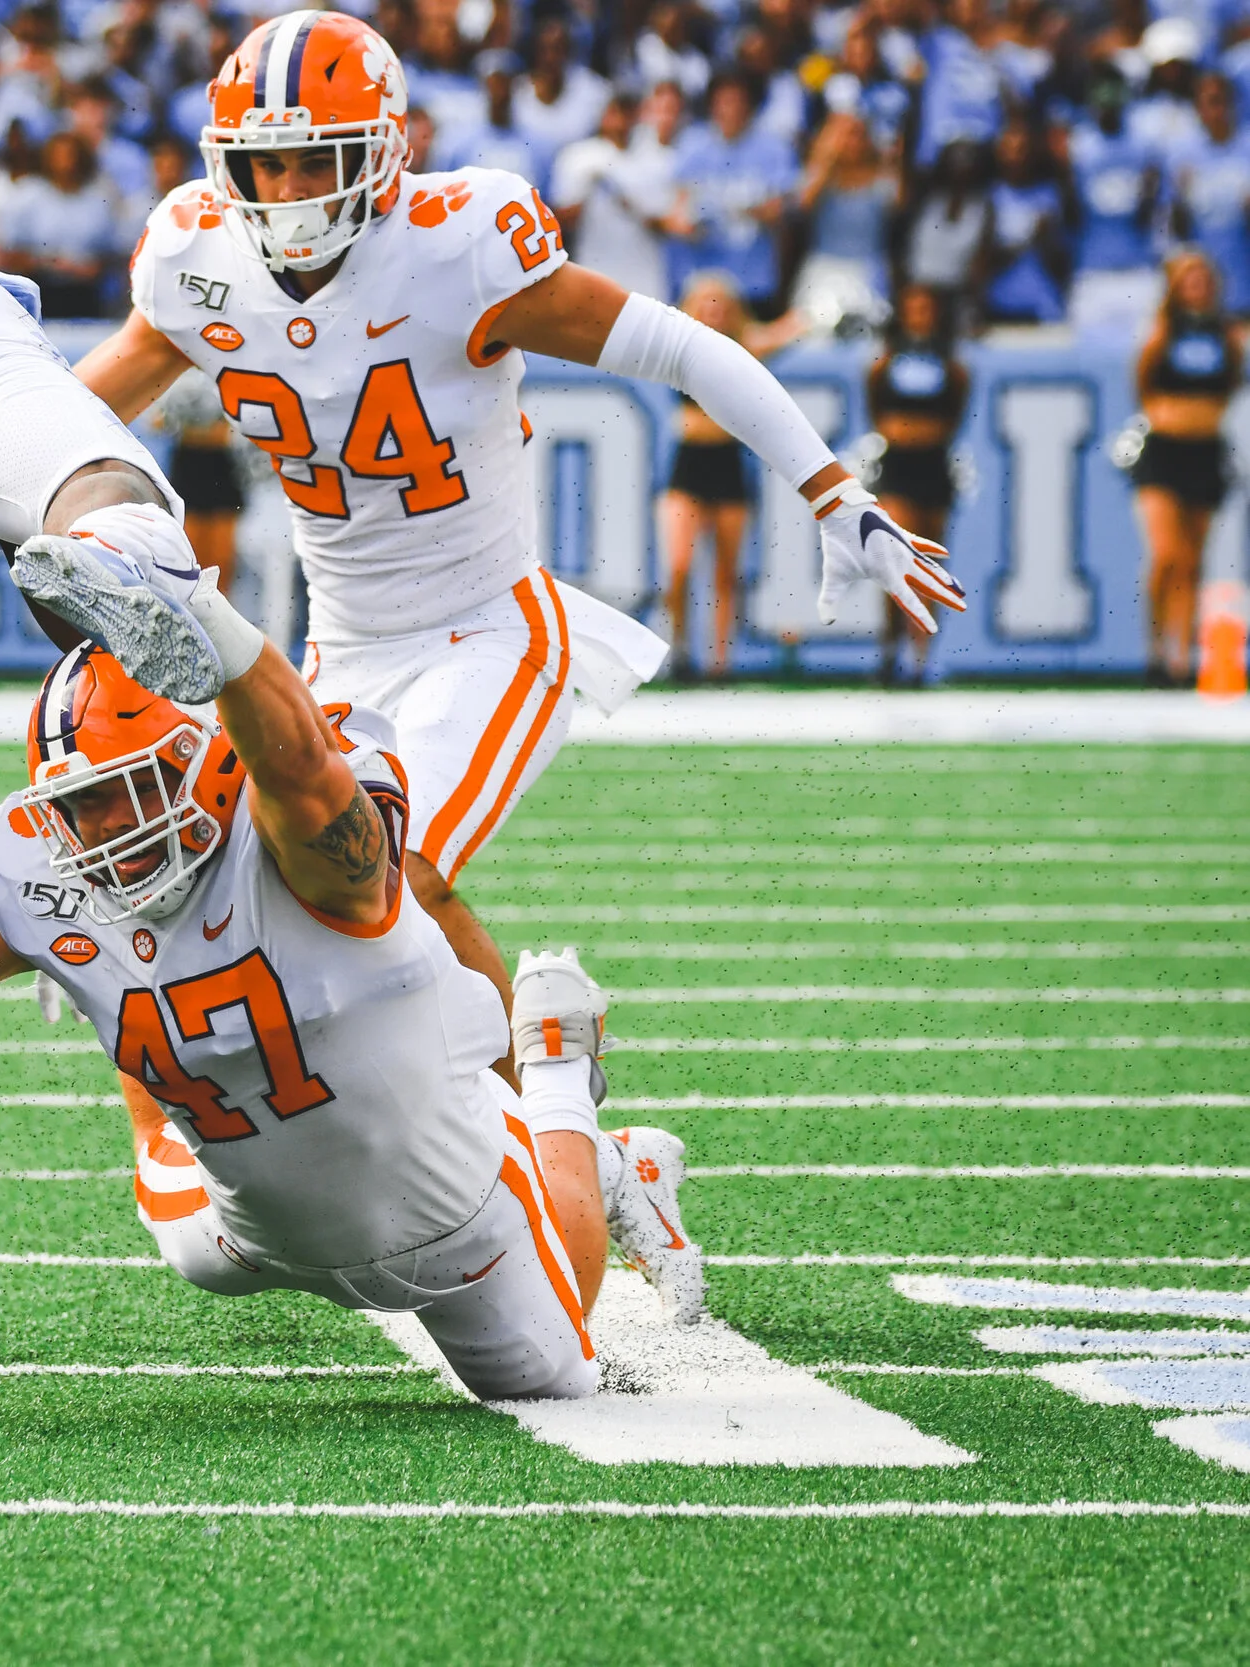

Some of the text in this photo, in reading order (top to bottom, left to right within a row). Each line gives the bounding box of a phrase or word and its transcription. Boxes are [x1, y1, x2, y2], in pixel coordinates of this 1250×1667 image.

[495, 187, 564, 272] 24
[179, 272, 230, 311] 150
[206, 328, 237, 341] ACC
[216, 357, 470, 520] 24
[22, 882, 87, 919] 150
[57, 940, 92, 952] ACC
[115, 946, 336, 1144] 47
